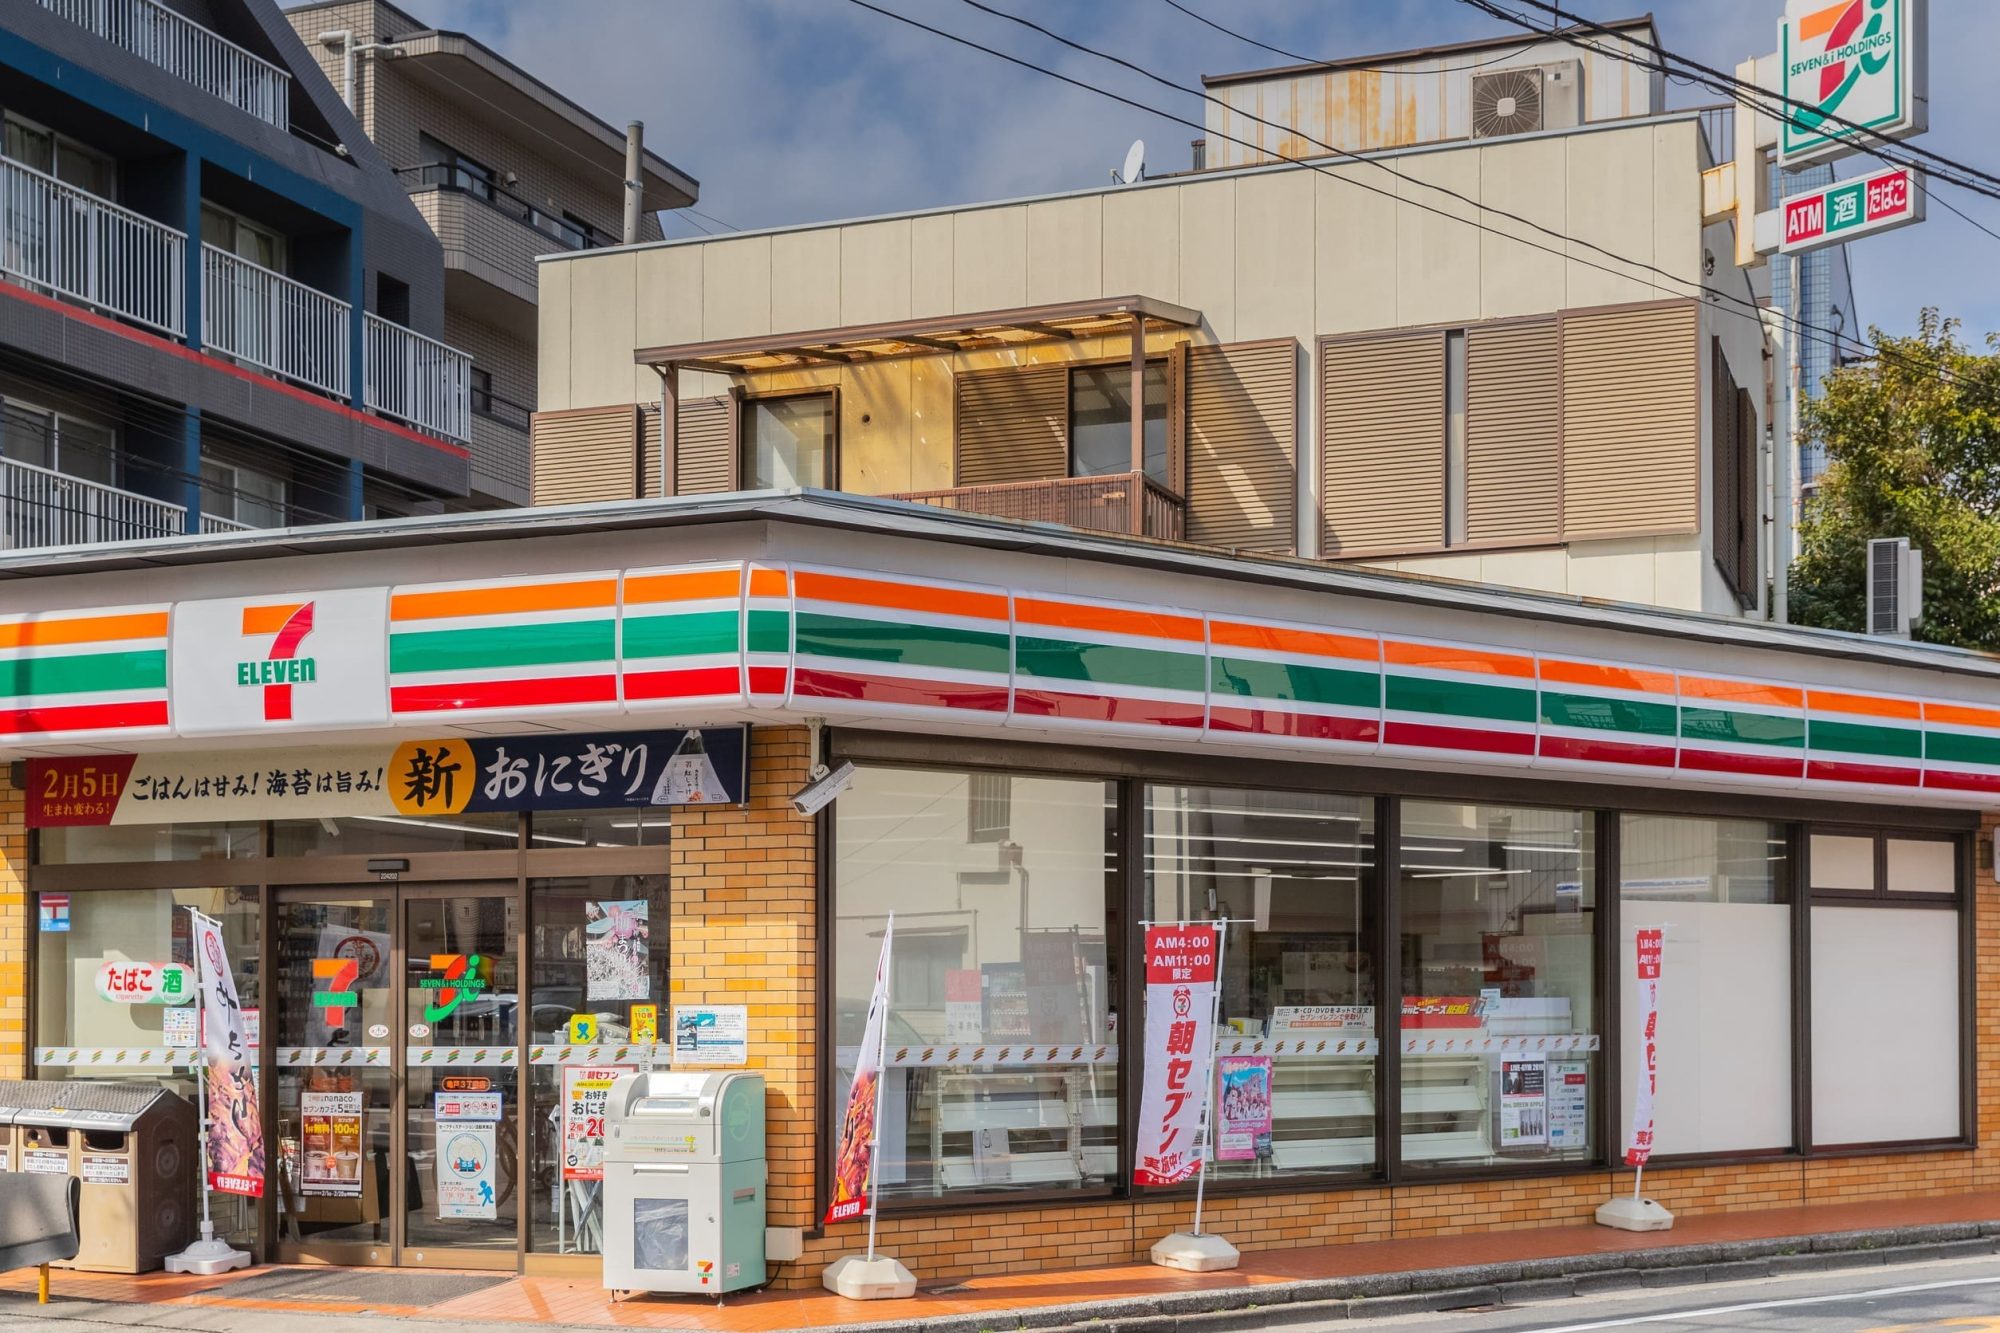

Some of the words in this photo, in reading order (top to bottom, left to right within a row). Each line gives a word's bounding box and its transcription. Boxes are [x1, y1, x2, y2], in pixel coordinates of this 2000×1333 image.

[1837, 31, 1892, 60] HOLDINGS
[1833, 191, 1857, 226] 酒
[1868, 179, 1907, 214] たばこ
[1787, 201, 1822, 237] ATM
[237, 656, 317, 686] ELEVEn
[43, 767, 119, 799] 2月5日
[131, 773, 259, 801] ごはんは甘み!
[266, 768, 384, 797] 海苔は旨み!
[402, 746, 463, 809] 新
[484, 743, 648, 800] おにぎり
[1154, 936, 1210, 949] AM4:00
[1153, 954, 1211, 967] AM11:00
[1172, 968, 1192, 980] 限定
[108, 968, 153, 992] たばこ
[162, 969, 183, 993] 酒
[1159, 1020, 1196, 1154] 朝セブン
